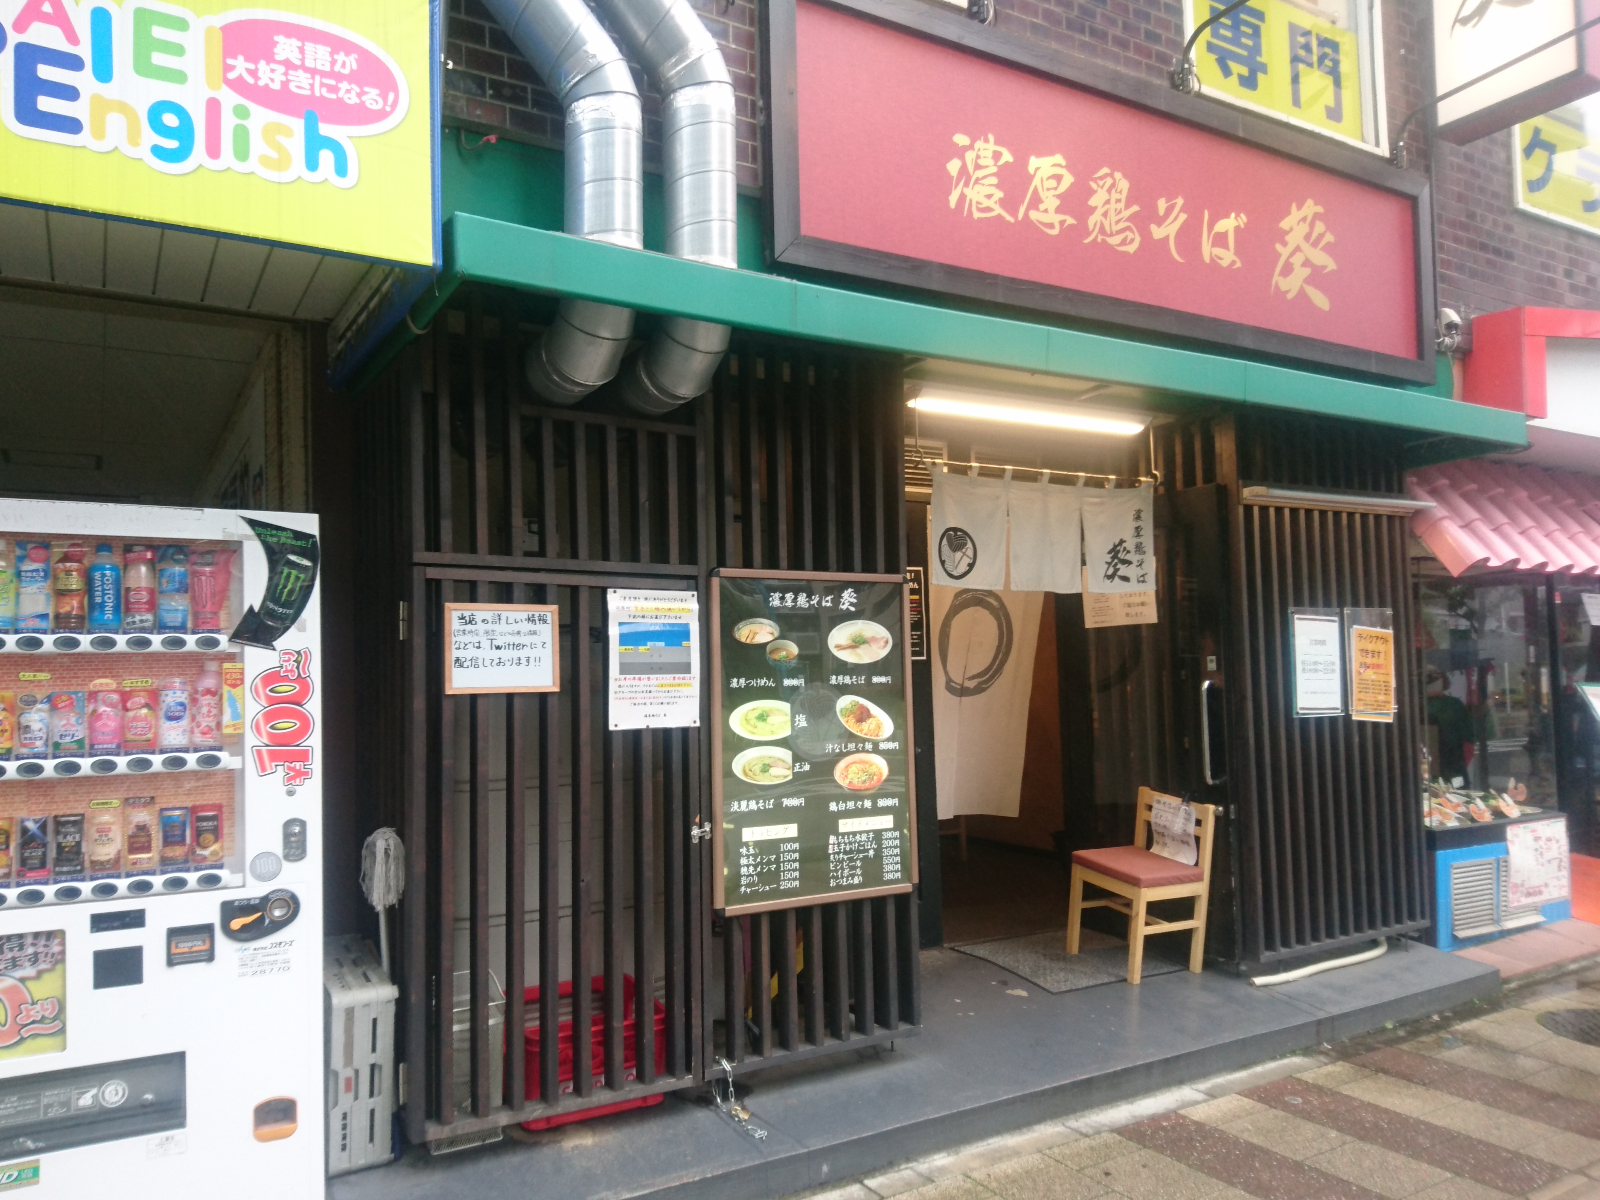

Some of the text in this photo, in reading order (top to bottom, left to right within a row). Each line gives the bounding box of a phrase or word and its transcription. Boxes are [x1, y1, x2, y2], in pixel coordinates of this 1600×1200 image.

[273, 34, 359, 74] 英語が
[13, 41, 348, 179] English
[945, 133, 1338, 312] 濃厚鶏そば 葵
[254, 526, 294, 538] Unleash
[260, 534, 279, 544] the
[1131, 508, 1148, 585] 濃厚鶏そば
[1102, 538, 1133, 584] 葵
[94, 571, 103, 604] WATER
[103, 570, 114, 621] POSTONIC
[768, 587, 858, 612] 濃厚鶏そば 葵
[457, 612, 551, 627] 当店の詳しい情報
[1356, 633, 1390, 646] テイクアウト
[729, 677, 776, 688] 濃厚つけめん
[829, 674, 865, 685] 濃厚鶏そば
[794, 713, 808, 729] 塩
[793, 761, 811, 773] 正油
[730, 799, 775, 812] 淡麗鶏そば
[751, 826, 790, 839] トッピング
[881, 830, 900, 839] 380円
[739, 842, 800, 856] 味玉 100円
[881, 839, 900, 848] 200円
[882, 847, 900, 856] 350円
[739, 852, 800, 866] 極太メンマ 150円
[882, 855, 901, 864] 550円
[779, 862, 800, 871] 150円
[829, 863, 902, 878] ハイボール 380円
[739, 870, 800, 885] 岩のり 150円
[882, 871, 902, 881] 380円
[739, 880, 800, 895] チャーシュー 250円
